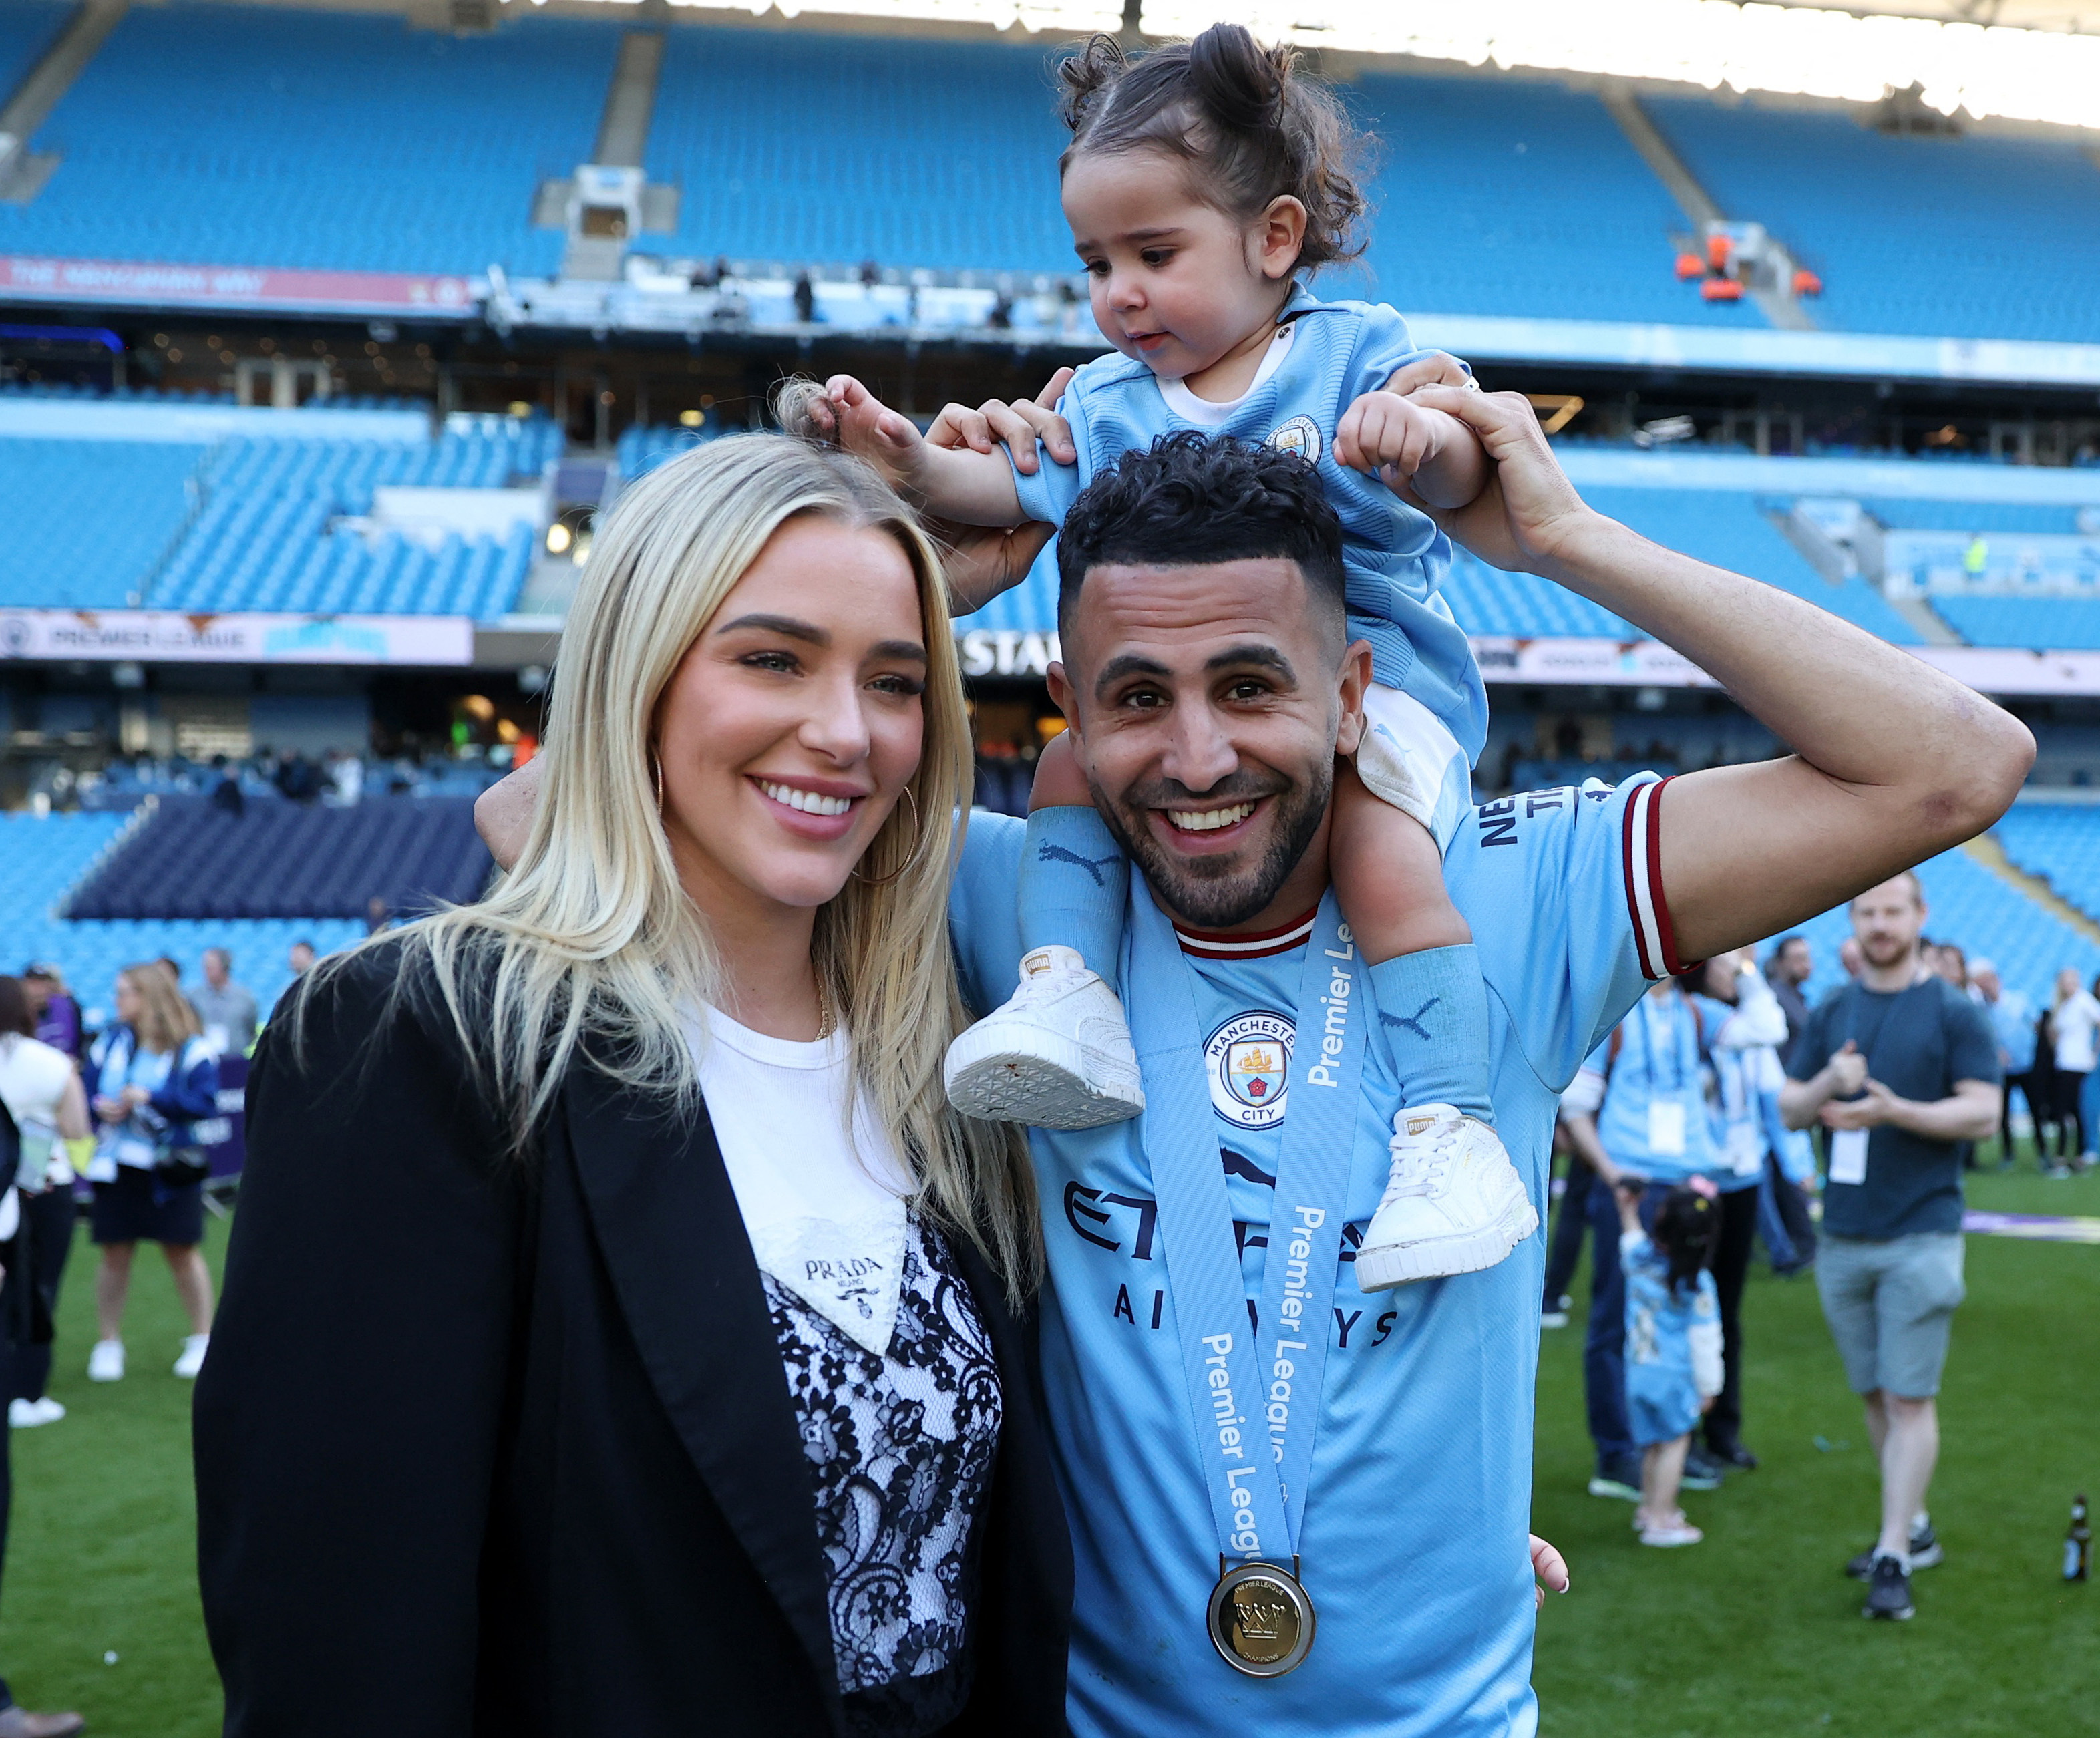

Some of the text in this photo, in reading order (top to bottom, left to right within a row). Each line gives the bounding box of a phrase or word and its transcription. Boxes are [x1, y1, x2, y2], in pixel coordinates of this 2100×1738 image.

[1526, 787, 1564, 818] TI
[1479, 796, 1518, 848] NE
[1026, 957, 1049, 973] PUMA
[1307, 922, 1354, 1088] Premier Le
[1241, 1109, 1275, 1121] CITY
[805, 1257, 883, 1280] PRADA
[1280, 1205, 1326, 1333] Premier
[1202, 1332, 1247, 1460] Premier
[1234, 1580, 1285, 1596] PREMIER LEAGUE
[1242, 1651, 1279, 1663] CHAMPIONS
